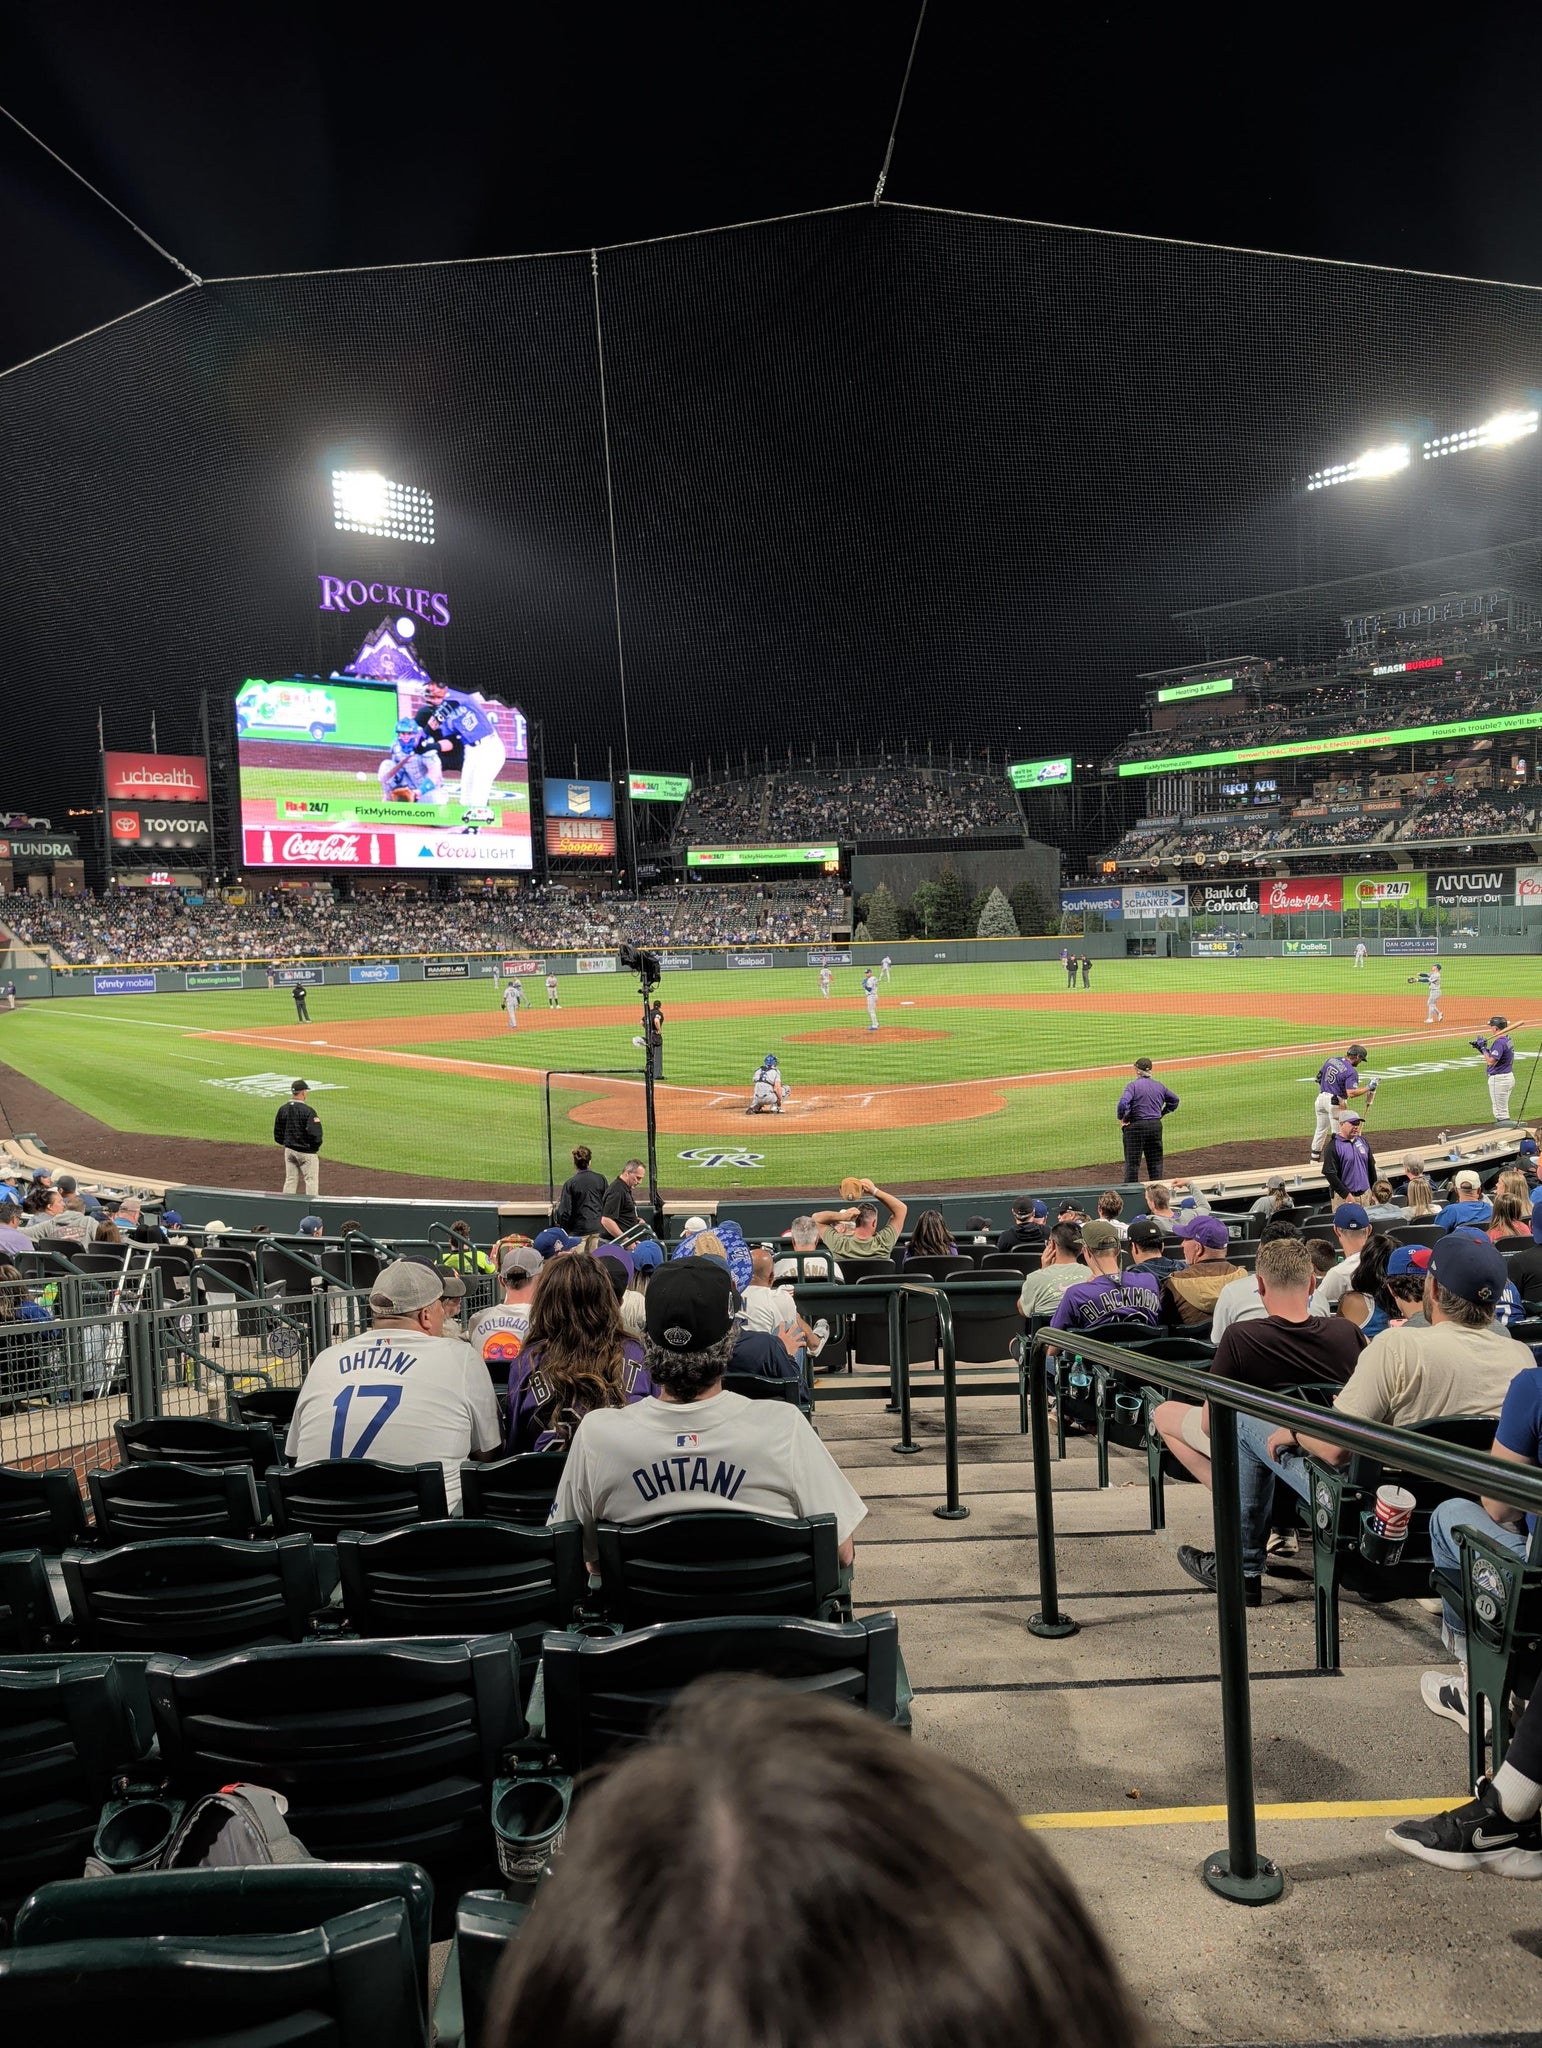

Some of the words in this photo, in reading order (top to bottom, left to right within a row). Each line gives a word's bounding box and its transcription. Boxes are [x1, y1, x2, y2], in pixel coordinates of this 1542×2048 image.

[318, 575, 451, 627] ROCKIES
[1344, 615, 1381, 638] THE
[1397, 594, 1498, 630] ROOFTOP
[1373, 657, 1444, 676] SMASHBURGER
[1175, 687, 1199, 696] Heating
[1432, 728, 1457, 736] House
[1468, 721, 1502, 732] trouble?
[1504, 718, 1524, 727] We'll
[1526, 717, 1537, 725] be
[1288, 744, 1321, 754] Plumbing
[1329, 739, 1362, 748] Electrical
[1143, 760, 1192, 770] FixMyHome.com
[122, 766, 193, 785] uchealth
[1254, 780, 1277, 791] AZUL
[309, 802, 328, 812] 24/7
[355, 806, 435, 818] FixMyHome.com
[1335, 805, 1359, 813] birdcall
[144, 819, 208, 832] TOYOTA
[559, 821, 603, 838] KING
[10, 842, 73, 856] TUNDRA
[282, 832, 359, 862] Coca-Cola
[435, 841, 477, 859] Coors
[479, 848, 516, 859] LIGHT
[560, 838, 604, 853] Soopers
[637, 865, 654, 873] PLATTE
[1102, 862, 1116, 872] 1:09
[1386, 882, 1410, 894] 24/7
[1436, 873, 1503, 891] ARROW
[1135, 890, 1169, 899] BACHUS
[1205, 886, 1233, 900] Bank
[1235, 884, 1248, 898] of
[1061, 898, 1113, 911] Southwest
[1124, 898, 1169, 908] SCHANKER
[1205, 899, 1259, 912] Colorado
[1198, 942, 1228, 951] bet365
[737, 957, 765, 966] dialpad
[196, 977, 226, 985] Huntington
[293, 971, 316, 980] MLB+
[97, 979, 124, 990] xfinity
[125, 978, 153, 987] mobile
[1325, 1065, 1339, 1085] 15
[1079, 1286, 1160, 1324] BLACKMON
[339, 1347, 418, 1376] OHTANI
[329, 1384, 404, 1460] 17
[632, 1456, 747, 1502] OHTANI
[1479, 1599, 1492, 1615] 10
